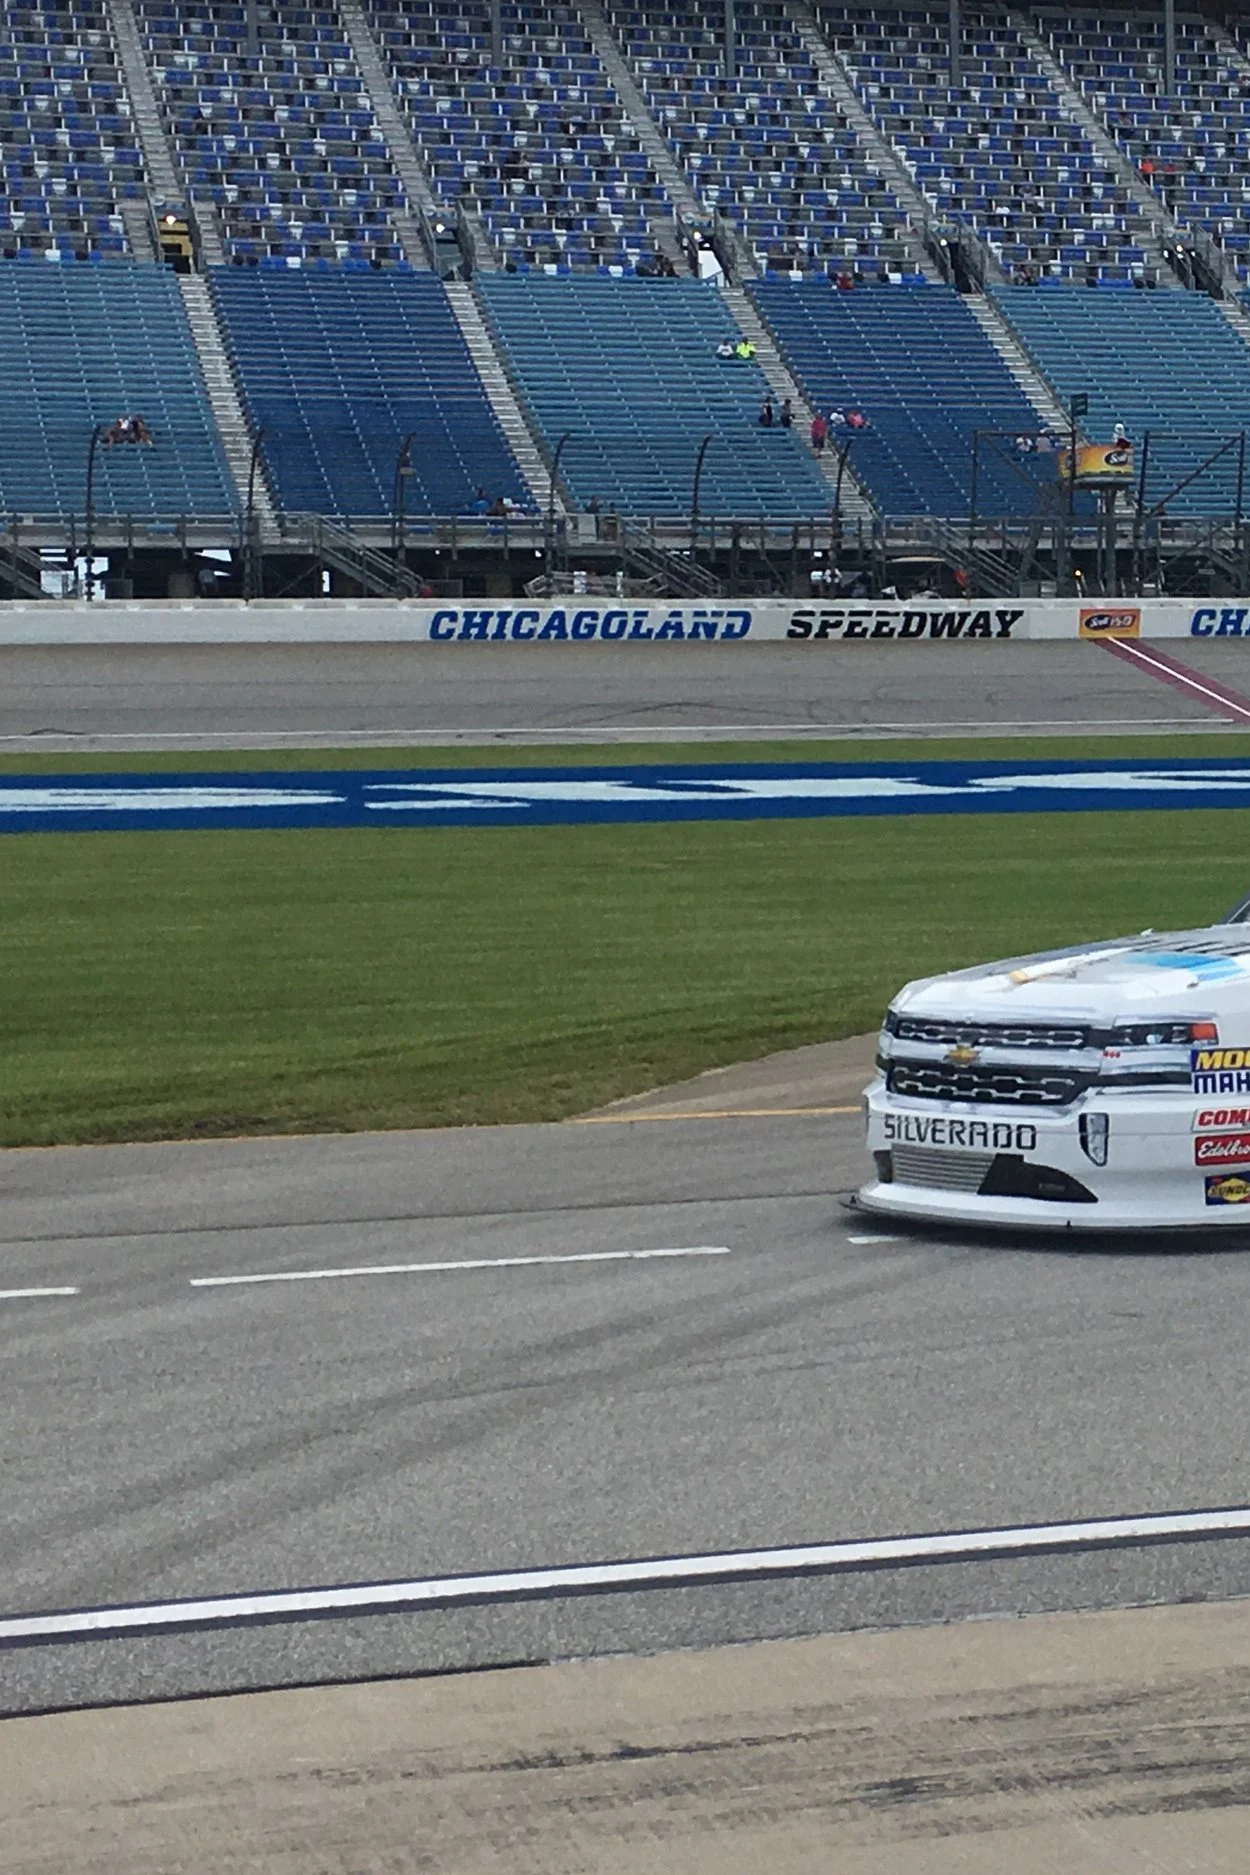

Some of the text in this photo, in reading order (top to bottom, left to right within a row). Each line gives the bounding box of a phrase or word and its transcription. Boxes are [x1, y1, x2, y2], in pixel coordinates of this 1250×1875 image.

[429, 609, 1025, 641] CHICAGOLAND SPEEDWAY
[884, 1113, 1037, 1150] SILVERADO
